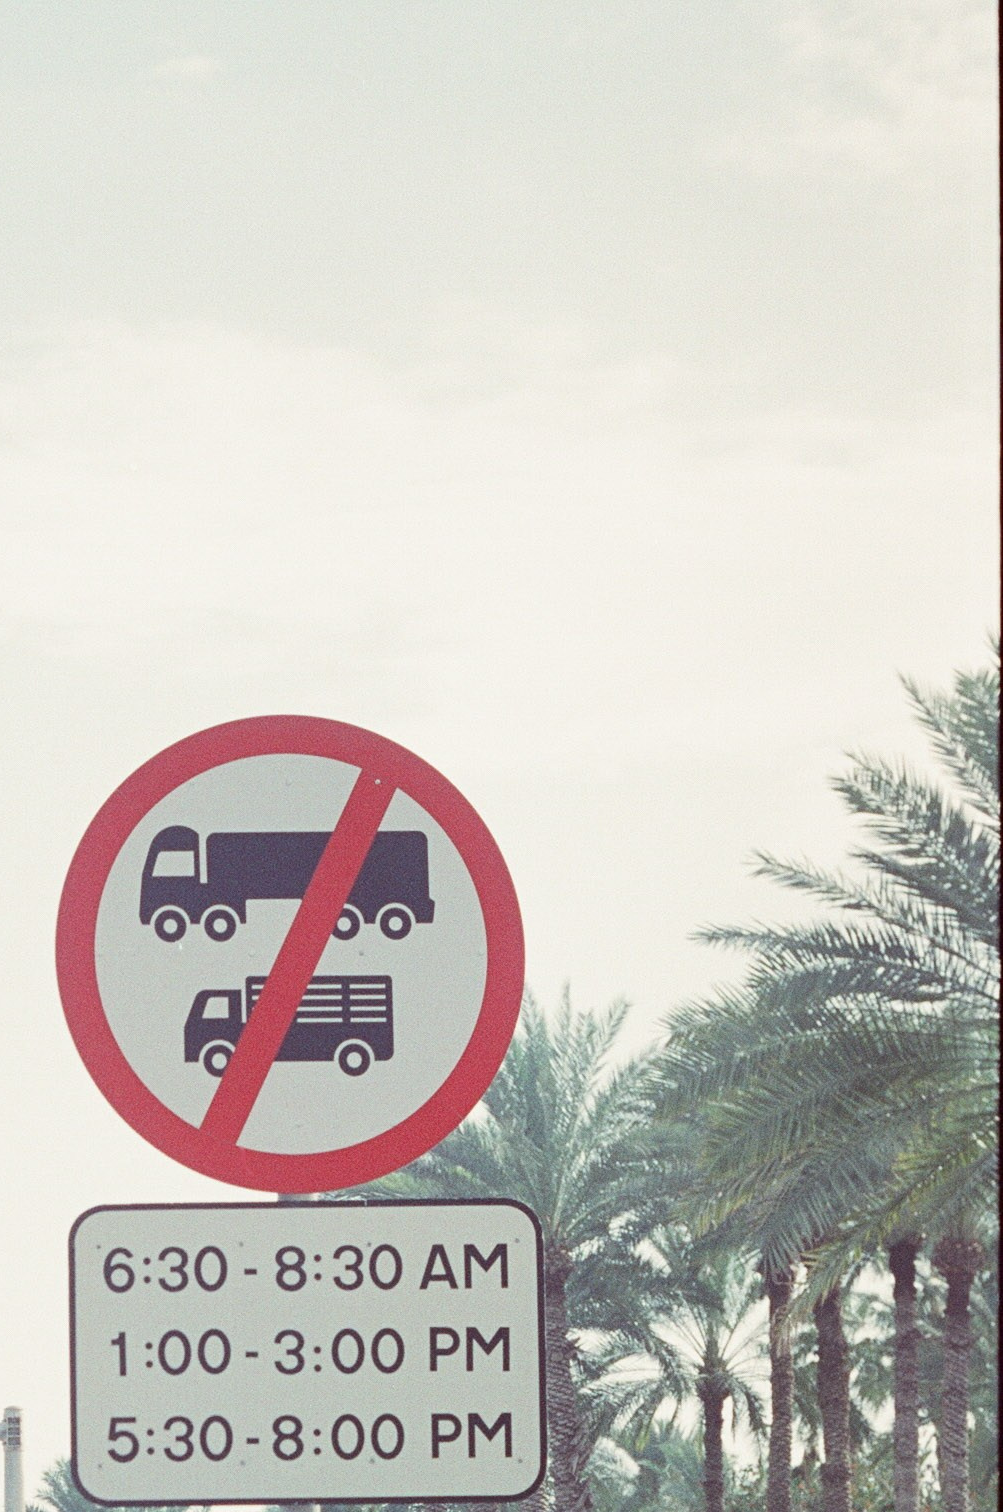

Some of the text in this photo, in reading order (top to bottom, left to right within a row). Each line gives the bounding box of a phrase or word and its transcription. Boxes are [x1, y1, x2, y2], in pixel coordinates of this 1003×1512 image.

[103, 1246, 228, 1293] 6:30
[275, 1244, 403, 1291] 8:30
[419, 1243, 509, 1290] AM
[111, 1328, 231, 1377] 1:00
[274, 1327, 405, 1375] 3:00
[429, 1326, 510, 1372] PM
[107, 1415, 233, 1463] 5:30
[272, 1413, 405, 1461] 8:00
[431, 1412, 513, 1459] PM
